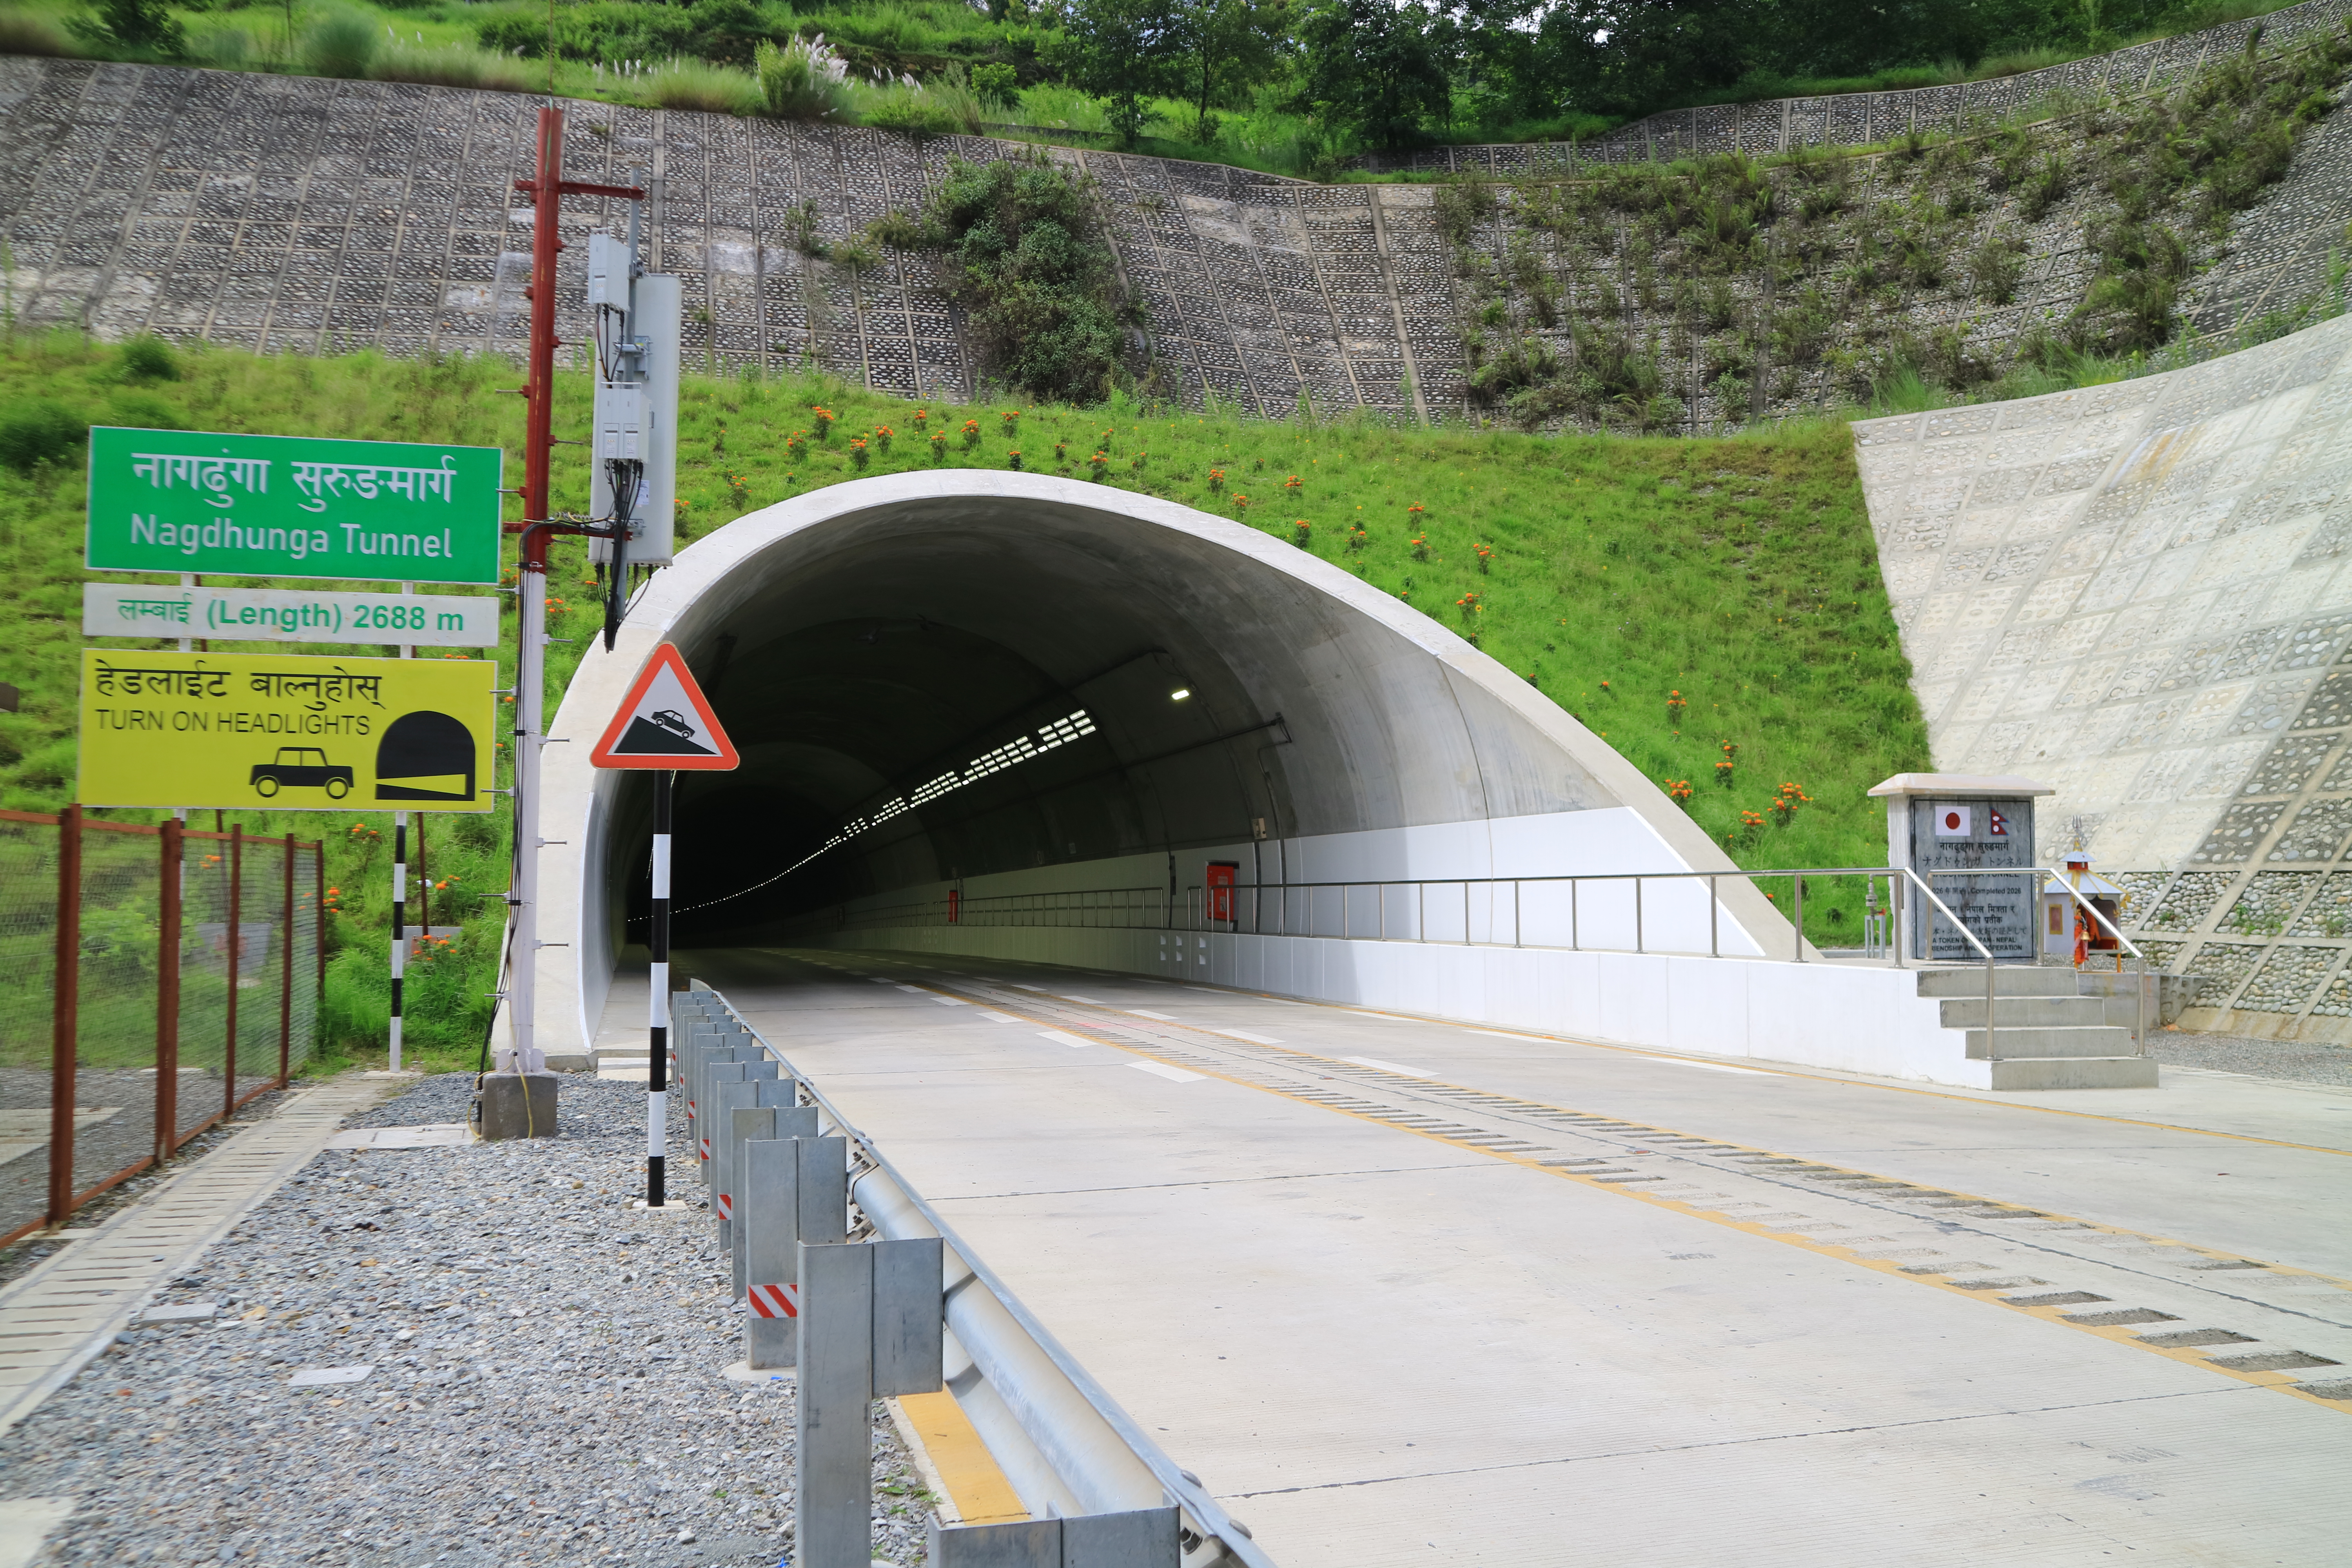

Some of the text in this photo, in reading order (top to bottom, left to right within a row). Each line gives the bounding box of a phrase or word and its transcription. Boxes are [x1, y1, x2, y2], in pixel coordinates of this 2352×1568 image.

[131, 448, 272, 508] नागढुंगा
[131, 513, 453, 560] Nagdhunga Tunnel
[207, 599, 342, 633] (Length)
[353, 605, 425, 630] 2688
[437, 613, 464, 631] m
[95, 659, 387, 711] हेडलाईट बाल्नुहोस्
[95, 709, 370, 735] TURN ON HEADLIGHTS
[1989, 856, 2023, 866] トンネル
